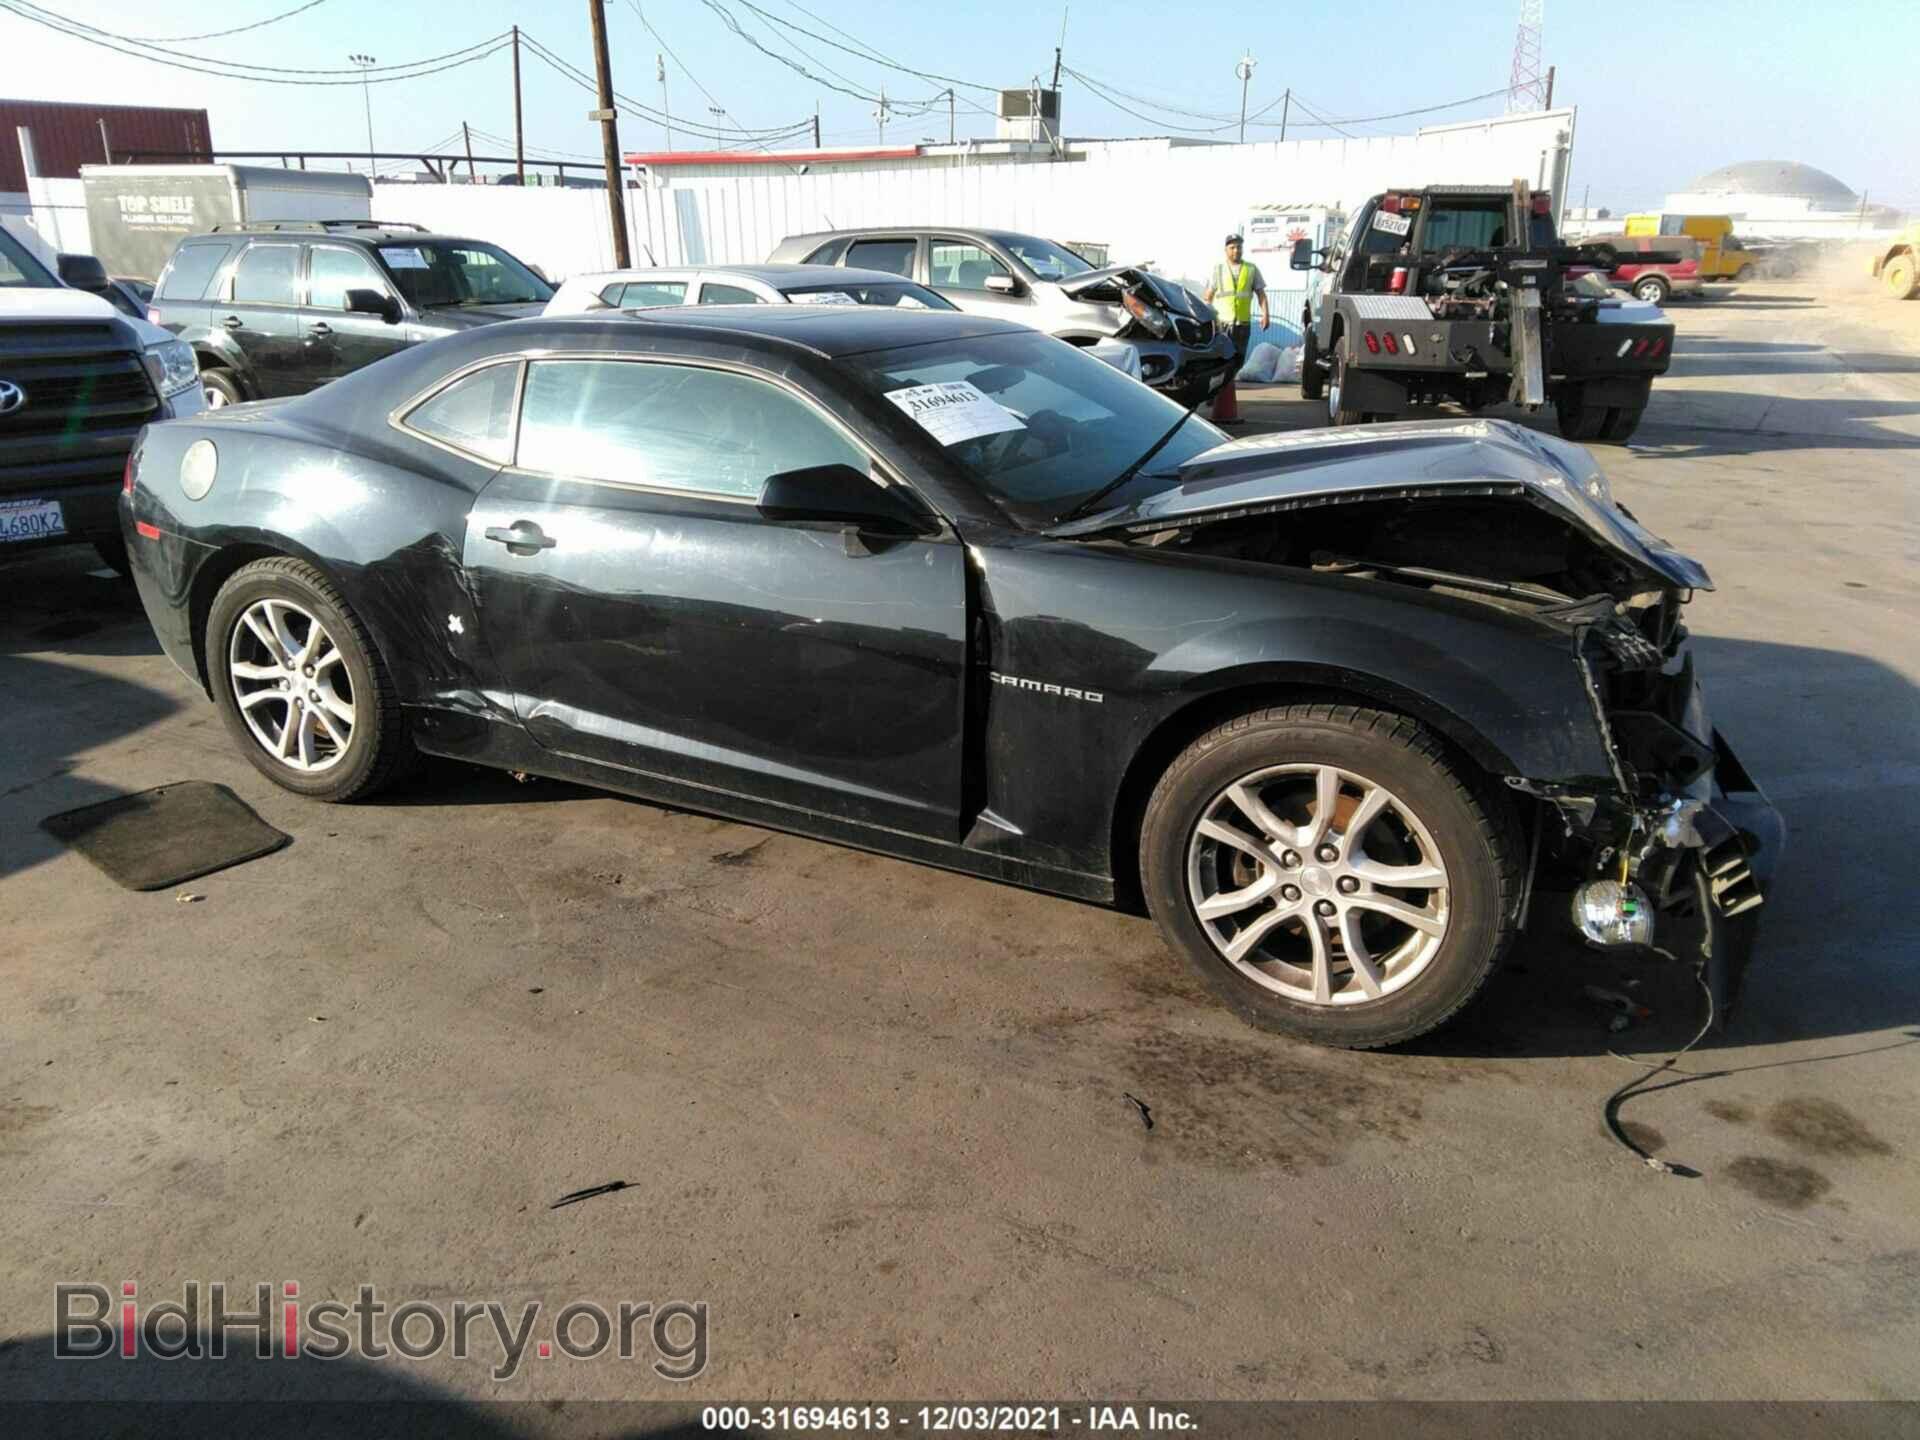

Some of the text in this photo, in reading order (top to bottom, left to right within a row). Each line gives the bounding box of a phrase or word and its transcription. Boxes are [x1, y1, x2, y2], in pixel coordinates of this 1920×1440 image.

[118, 195, 194, 214] TOP SHELF
[908, 391, 980, 412] 31694613
[990, 671, 1103, 702] CAMARO
